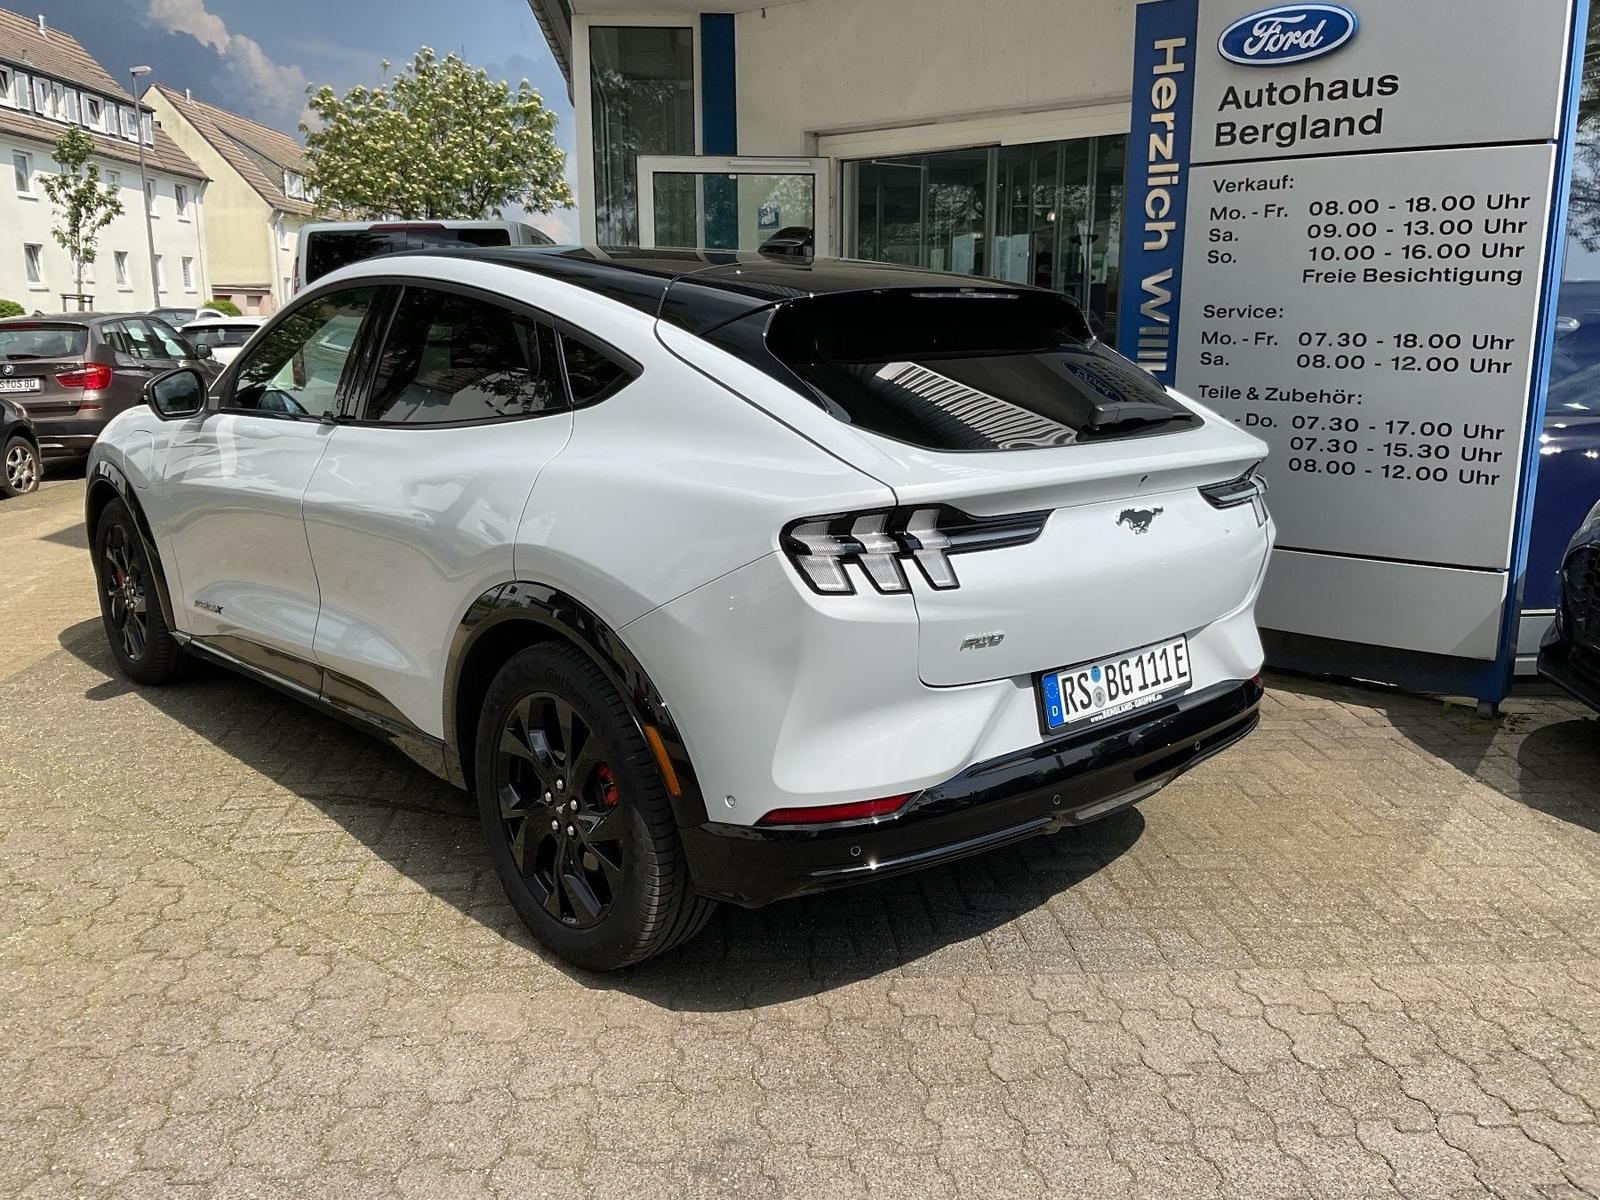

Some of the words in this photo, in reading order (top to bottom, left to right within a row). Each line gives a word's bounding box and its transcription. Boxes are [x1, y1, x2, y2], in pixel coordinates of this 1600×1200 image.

[1243, 14, 1327, 56] Ford
[1217, 73, 1400, 113] Autohaus
[1214, 107, 1384, 149] Bergland
[1143, 37, 1187, 250] Herzlich
[1212, 174, 1294, 194] Verkauf:
[1209, 206, 1246, 221] Mo.
[1264, 203, 1288, 219] Fr.
[1308, 198, 1379, 217] 08.00
[1405, 194, 1476, 213] 18.00
[1486, 193, 1531, 211] Uhr
[1208, 228, 1239, 243] Sa.
[1307, 221, 1377, 239] 09.00
[1403, 218, 1473, 237] 13.00
[1484, 218, 1528, 235] Uhr
[1207, 249, 1237, 264] So.
[1308, 244, 1375, 262] 10.00
[1401, 243, 1471, 260] 16.00
[1481, 242, 1526, 259] Uhr
[1302, 268, 1357, 284] Freie
[1362, 266, 1523, 286] Besichtigung
[1203, 304, 1284, 319] Service:
[1201, 330, 1237, 346] Mo.
[1254, 331, 1278, 346] Fr.
[1298, 331, 1367, 348] 07.30
[1393, 333, 1462, 350] 18.00
[1472, 334, 1515, 350] Uhr
[1199, 351, 1230, 366] Sa.
[1296, 353, 1366, 370] 08.00
[1390, 355, 1459, 373] 12.00
[1469, 357, 1513, 374] Uhr
[1198, 384, 1242, 400] Teile
[1246, 386, 1260, 401] &
[1264, 387, 1362, 405] Zubehör:
[1245, 412, 1278, 428] Do.
[1291, 415, 1359, 433] 07.30
[1385, 419, 1453, 438] 17.00
[1463, 423, 1505, 440] Uhr
[1290, 436, 1358, 454] 07.30
[1382, 442, 1450, 460] 15.30
[1461, 446, 1503, 463] Uhr
[1288, 457, 1356, 476] 08.00
[1380, 464, 1448, 483] 12.00
[1458, 468, 1501, 486] Uhr
[1061, 672, 1092, 715] RS
